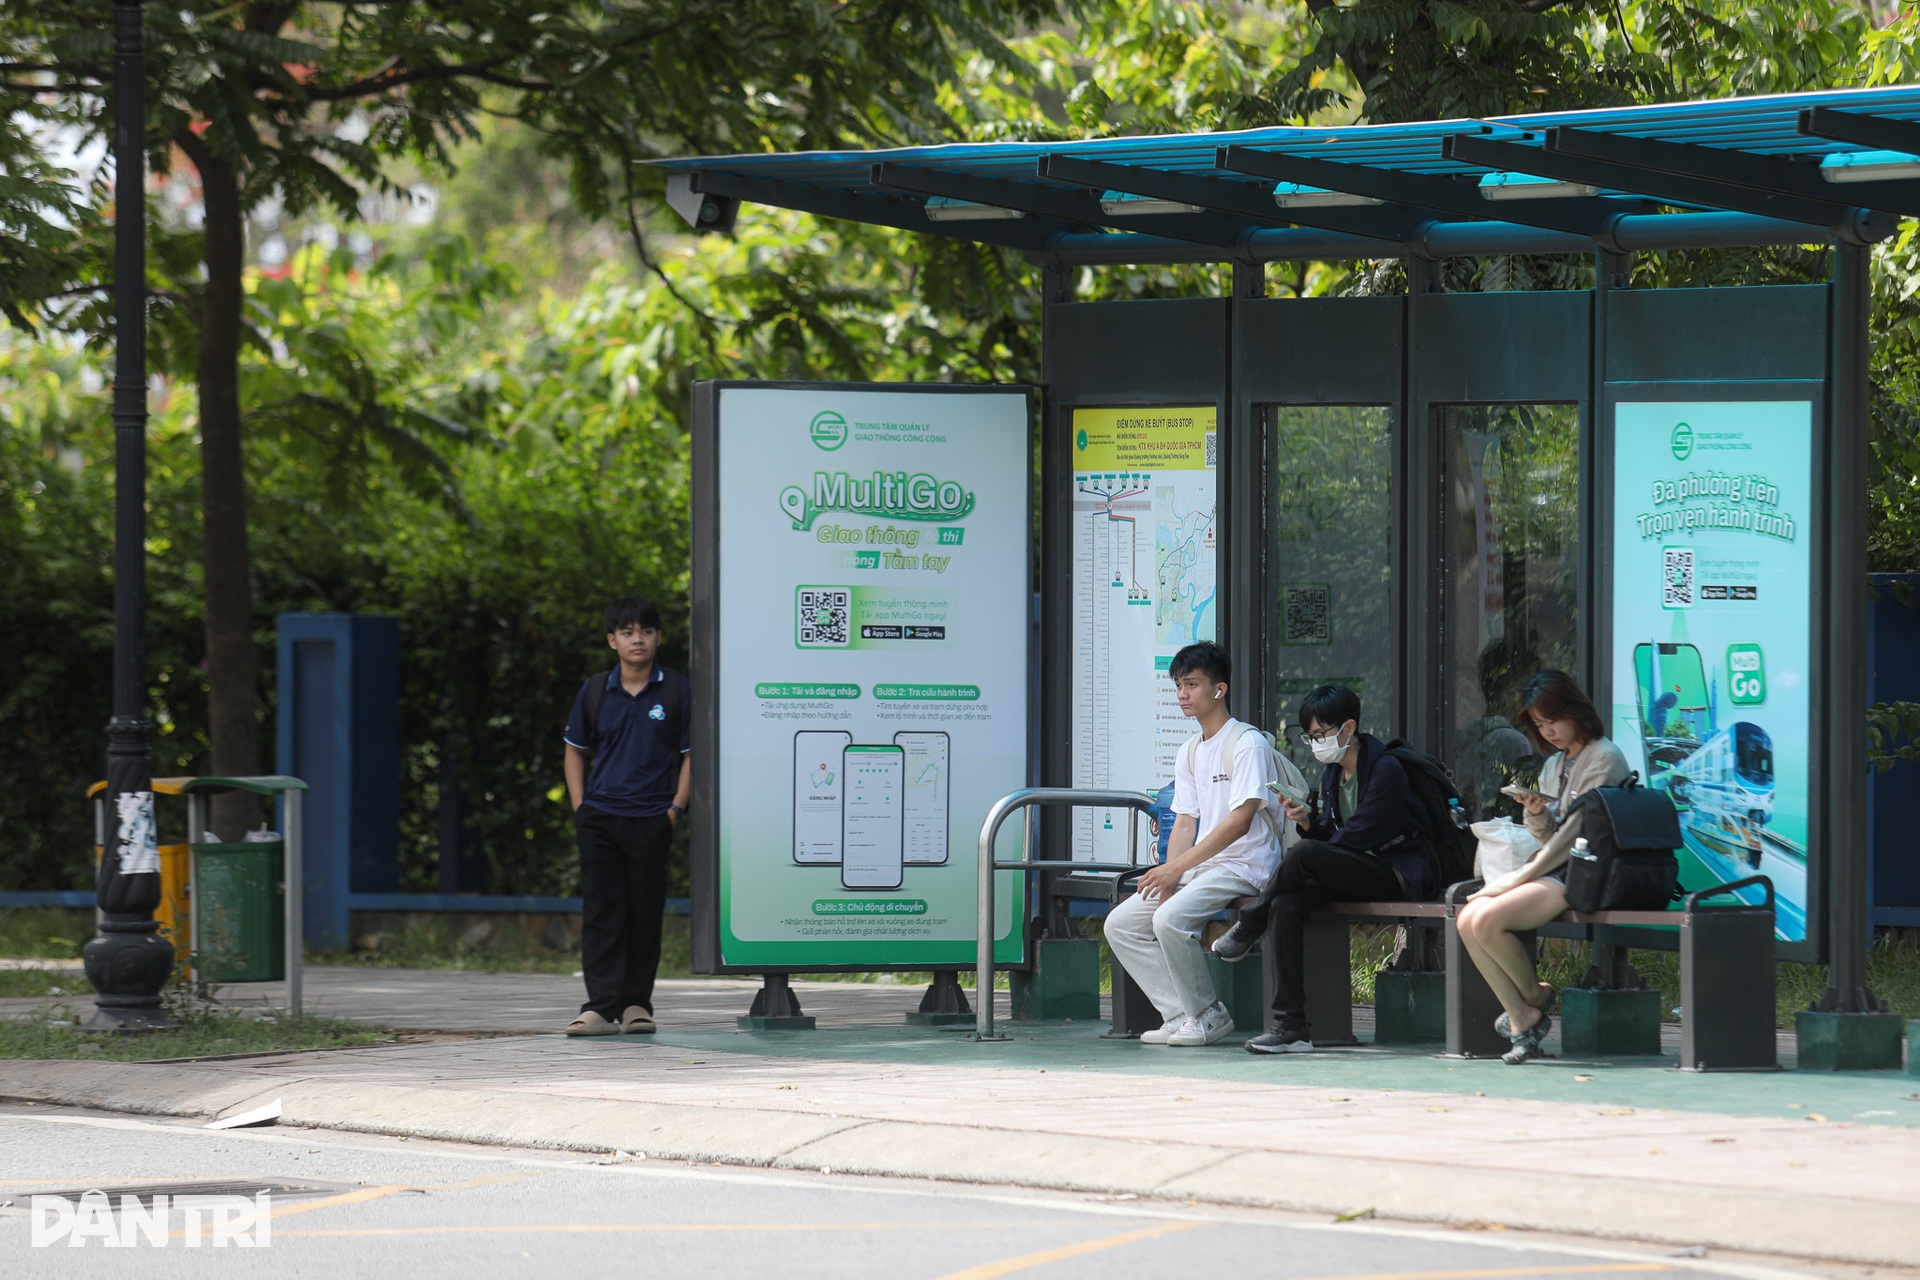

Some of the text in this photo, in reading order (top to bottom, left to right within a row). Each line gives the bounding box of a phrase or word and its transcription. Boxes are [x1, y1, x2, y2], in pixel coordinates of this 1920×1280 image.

[881, 422, 898, 430] TÂM
[899, 422, 921, 431] QUẢN
[922, 423, 930, 431] LÝ
[875, 433, 901, 442] THÔNG
[903, 434, 924, 442] CÔNG
[925, 434, 947, 444] CỘNG
[814, 471, 964, 513] MultiGo
[1652, 470, 1778, 510] Đa phương tiện
[1636, 502, 1796, 542] Trọn vẹn hành trình
[817, 524, 862, 544] Giao
[866, 525, 920, 548] thông
[942, 531, 959, 545] thị
[882, 548, 918, 570] Tầm
[922, 553, 951, 574] tay
[878, 598, 901, 609] tuyến
[904, 599, 926, 610] thông
[929, 600, 948, 608] minh
[861, 610, 946, 621] Tải app MultiGo ngay!
[1733, 654, 1757, 667] Multi
[1732, 672, 1760, 697] Go
[758, 687, 858, 697] Bước 1: Tải và đăng nhập
[877, 688, 976, 697] Bước 2: Tra cứu hành trình
[815, 901, 923, 913] Bước 3: Chủ động đi chuyển
